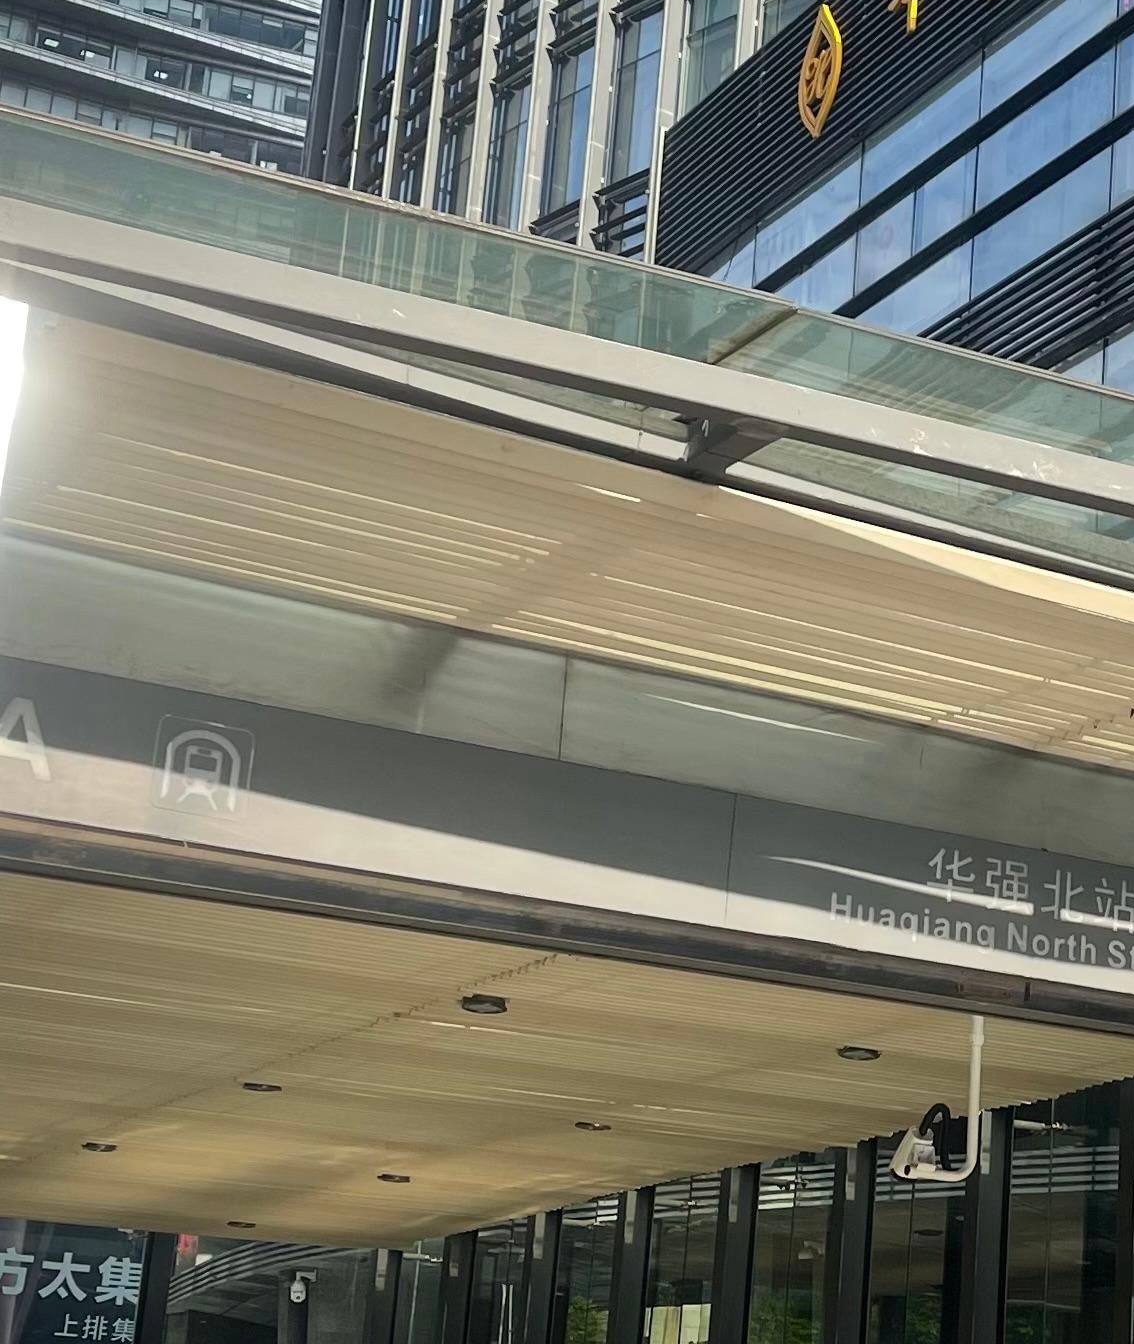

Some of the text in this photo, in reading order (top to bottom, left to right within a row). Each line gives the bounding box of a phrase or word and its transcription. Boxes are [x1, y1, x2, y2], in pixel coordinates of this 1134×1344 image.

[830, 891, 996, 954] Huaqiang
[1007, 921, 1097, 965] North
[54, 1313, 136, 1343] 上排集
